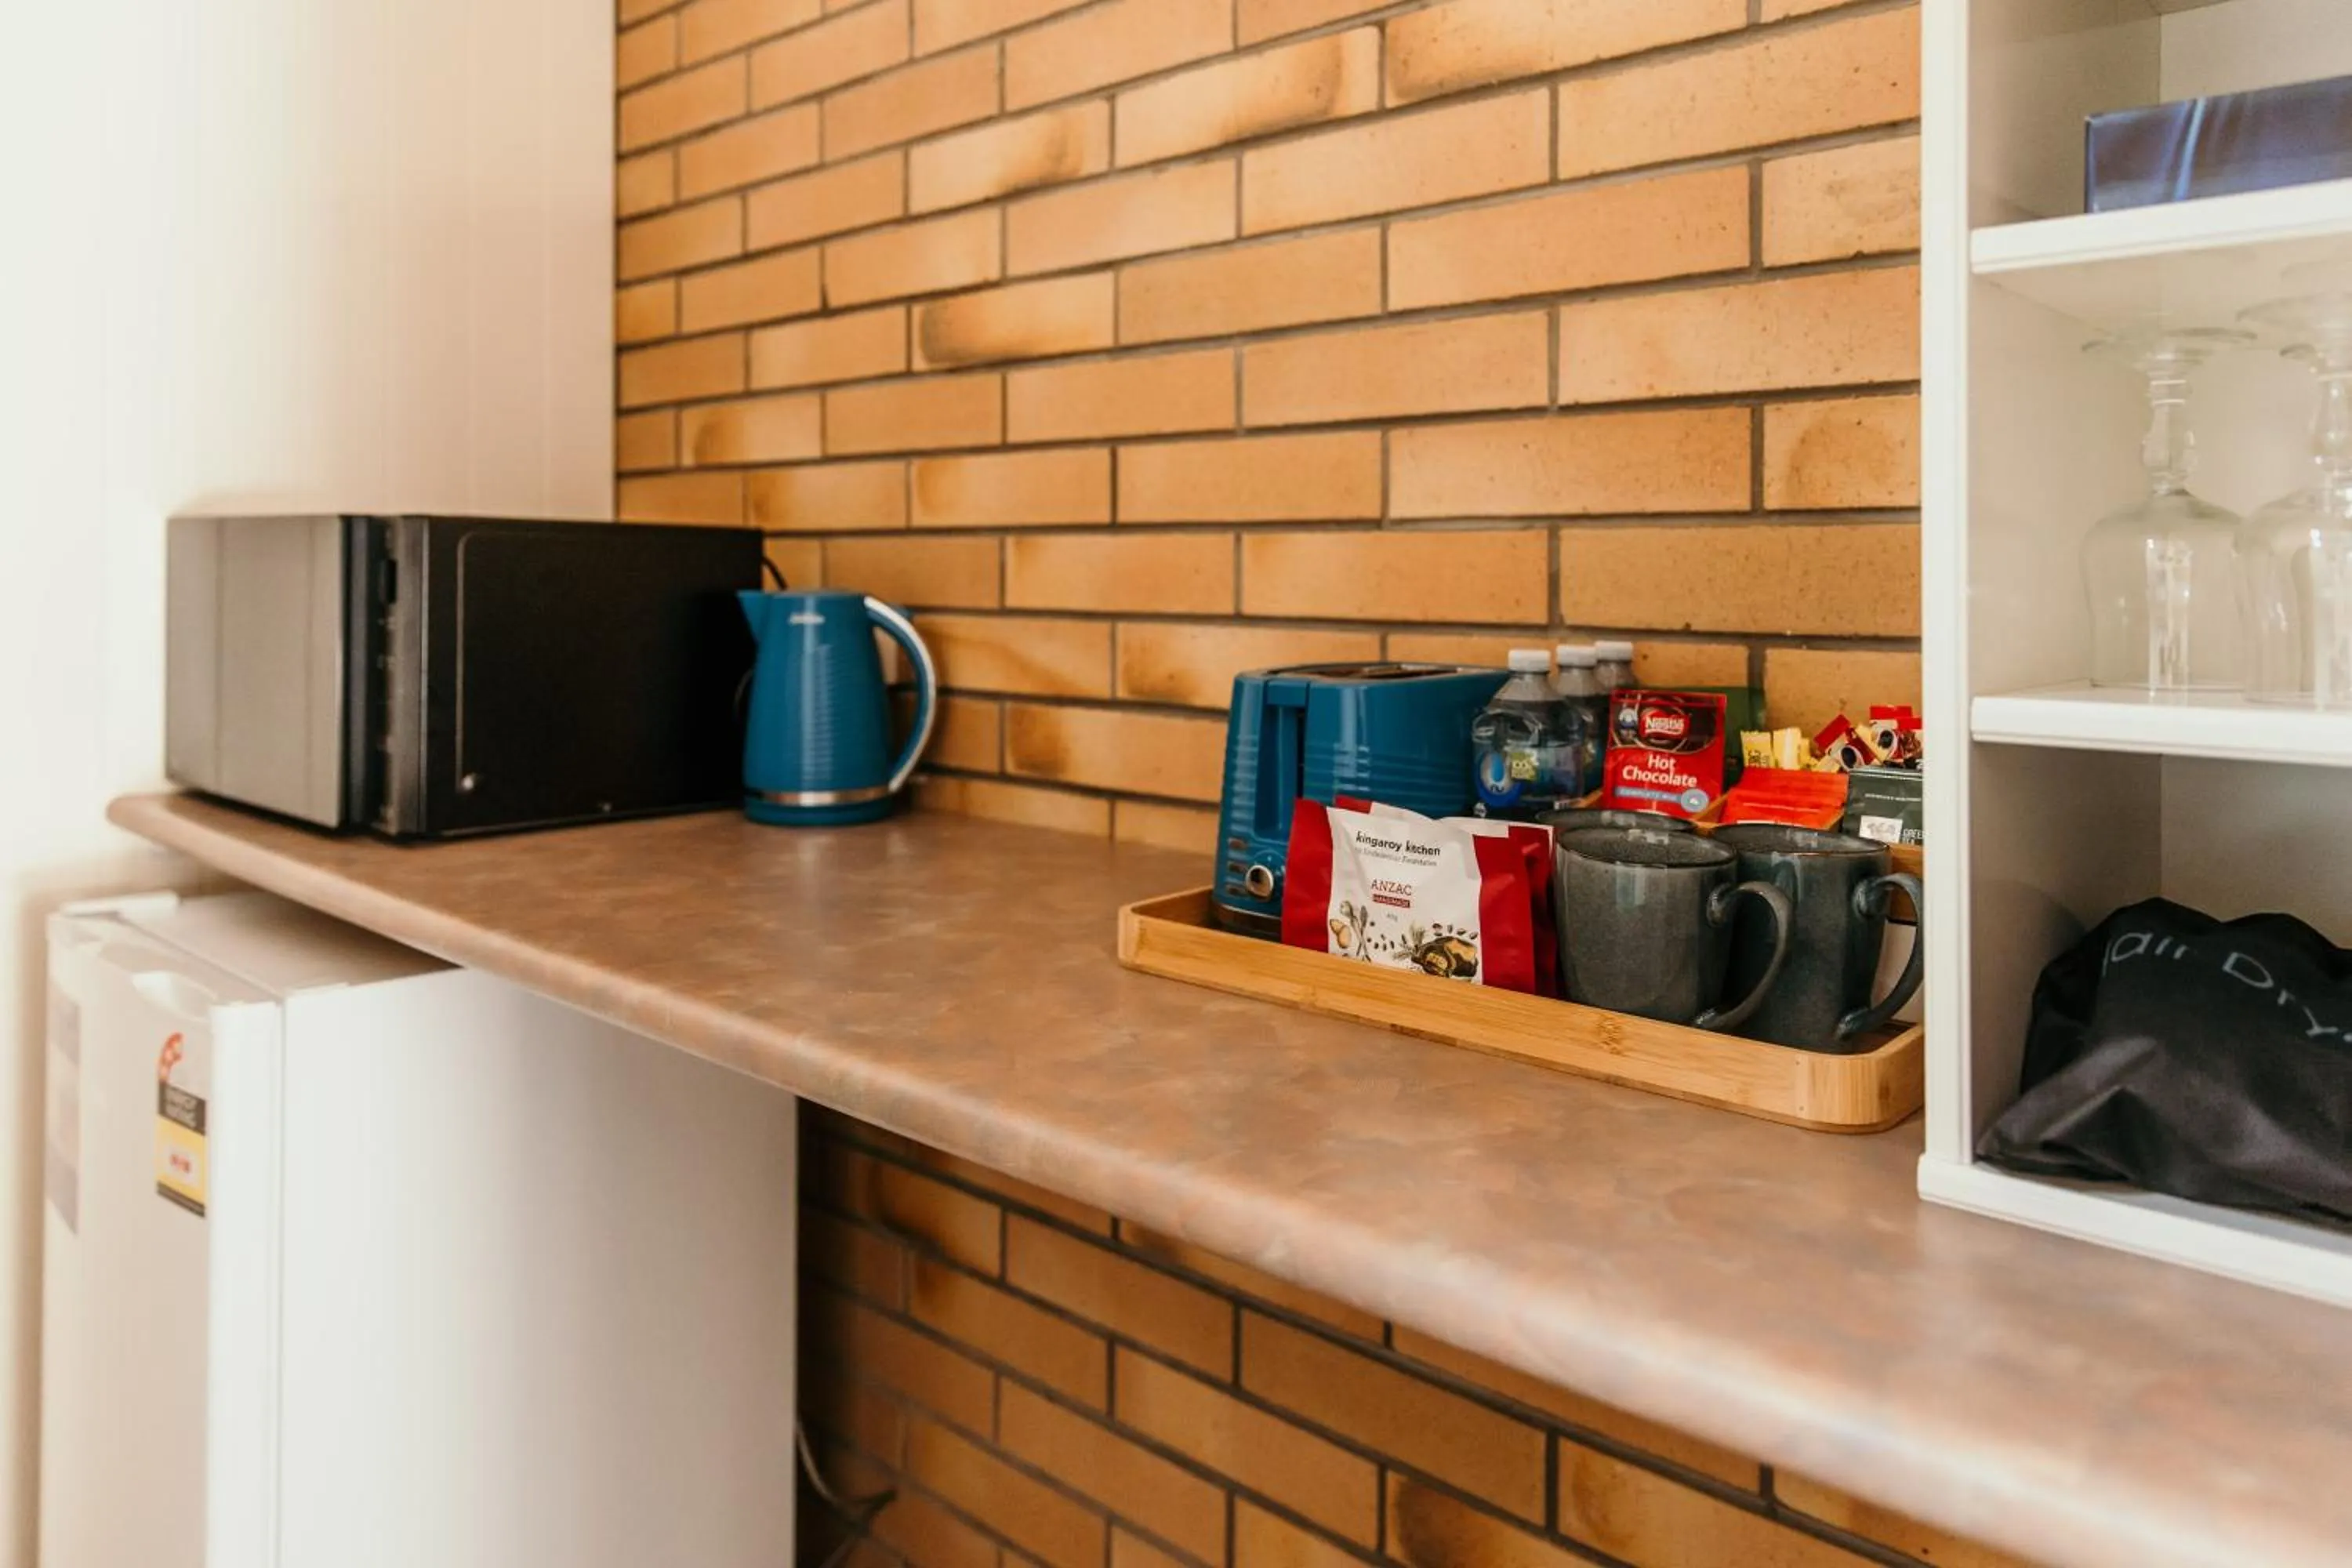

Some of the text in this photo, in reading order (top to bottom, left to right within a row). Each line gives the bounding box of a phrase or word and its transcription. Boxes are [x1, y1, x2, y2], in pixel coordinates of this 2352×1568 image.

[1648, 752, 1676, 771] Hot
[1622, 764, 1697, 787] Chocolate
[1356, 830, 1403, 852] kingaroy
[1371, 878, 1413, 896] ANZAC
